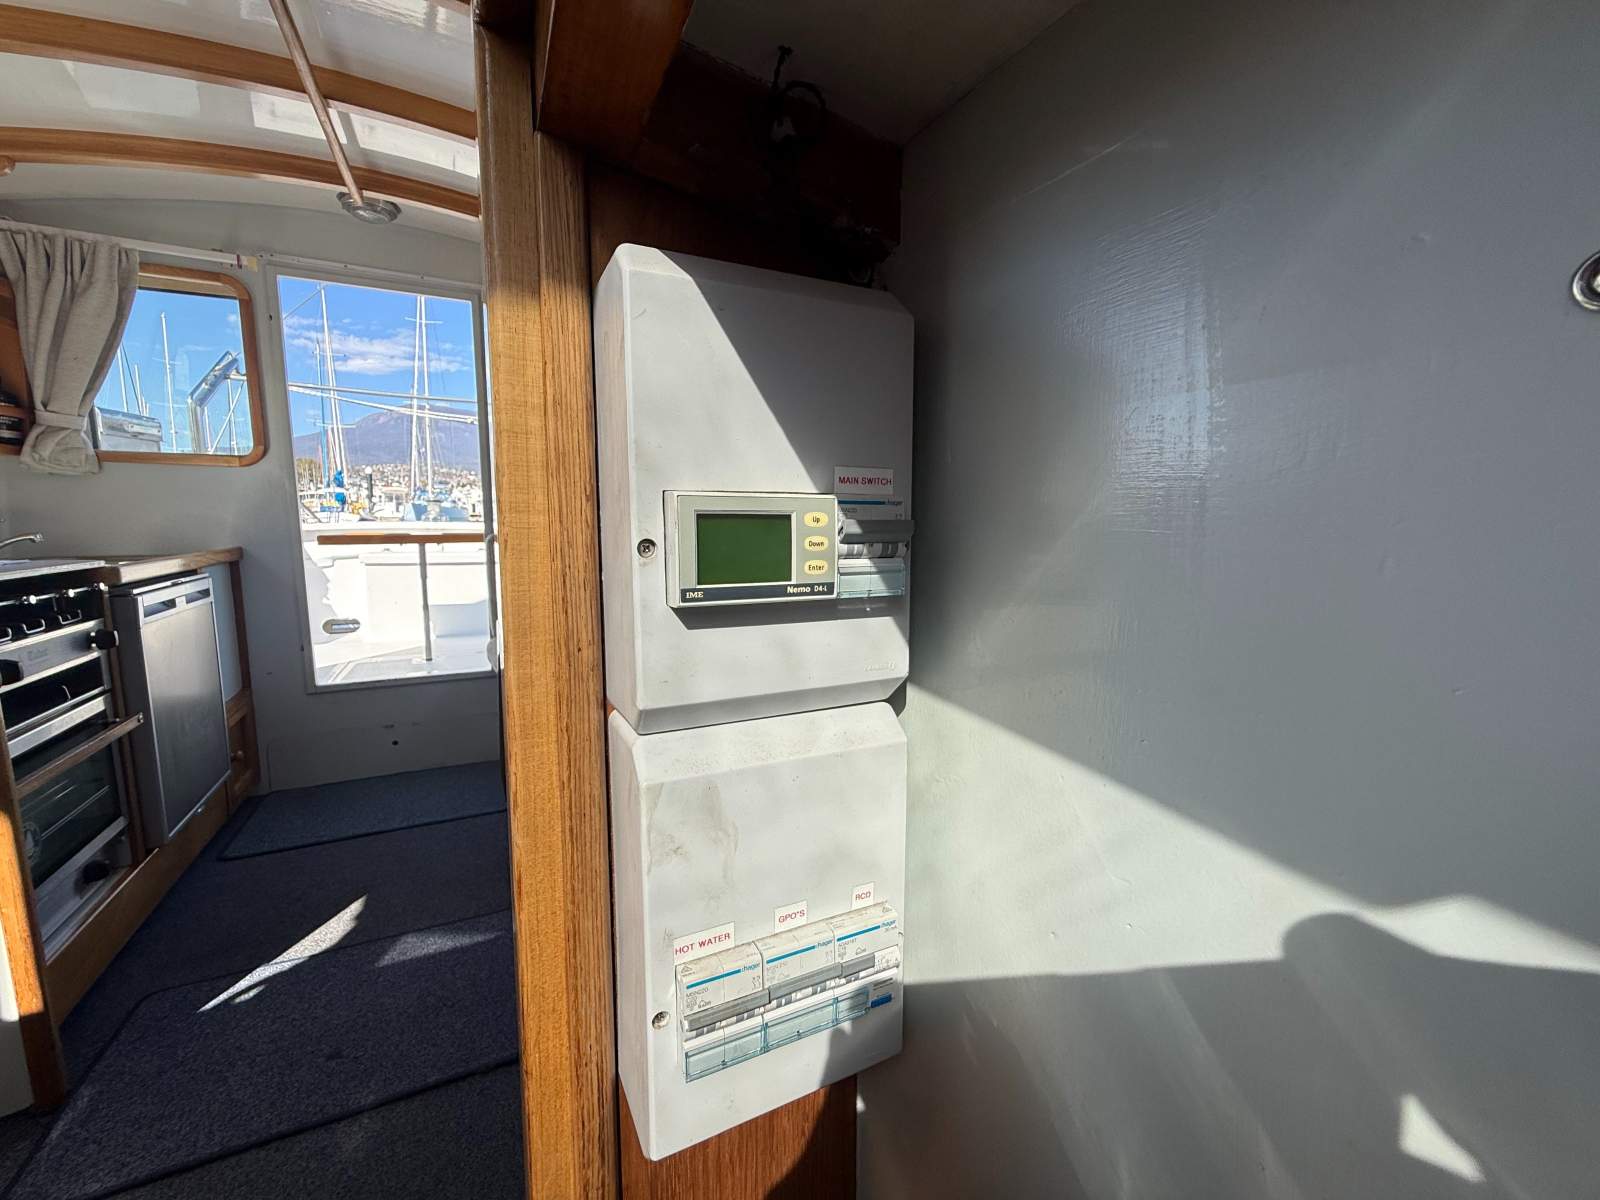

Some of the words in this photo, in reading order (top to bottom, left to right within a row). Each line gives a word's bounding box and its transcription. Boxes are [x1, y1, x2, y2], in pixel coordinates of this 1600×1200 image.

[838, 476, 859, 485] MAIN
[861, 476, 892, 486] SWITCH
[812, 516, 821, 524] Up
[787, 586, 811, 594] Nemo
[686, 591, 704, 599] IME
[855, 890, 872, 901] RCD
[674, 943, 695, 955] HOT
[698, 932, 731, 949] WATER
